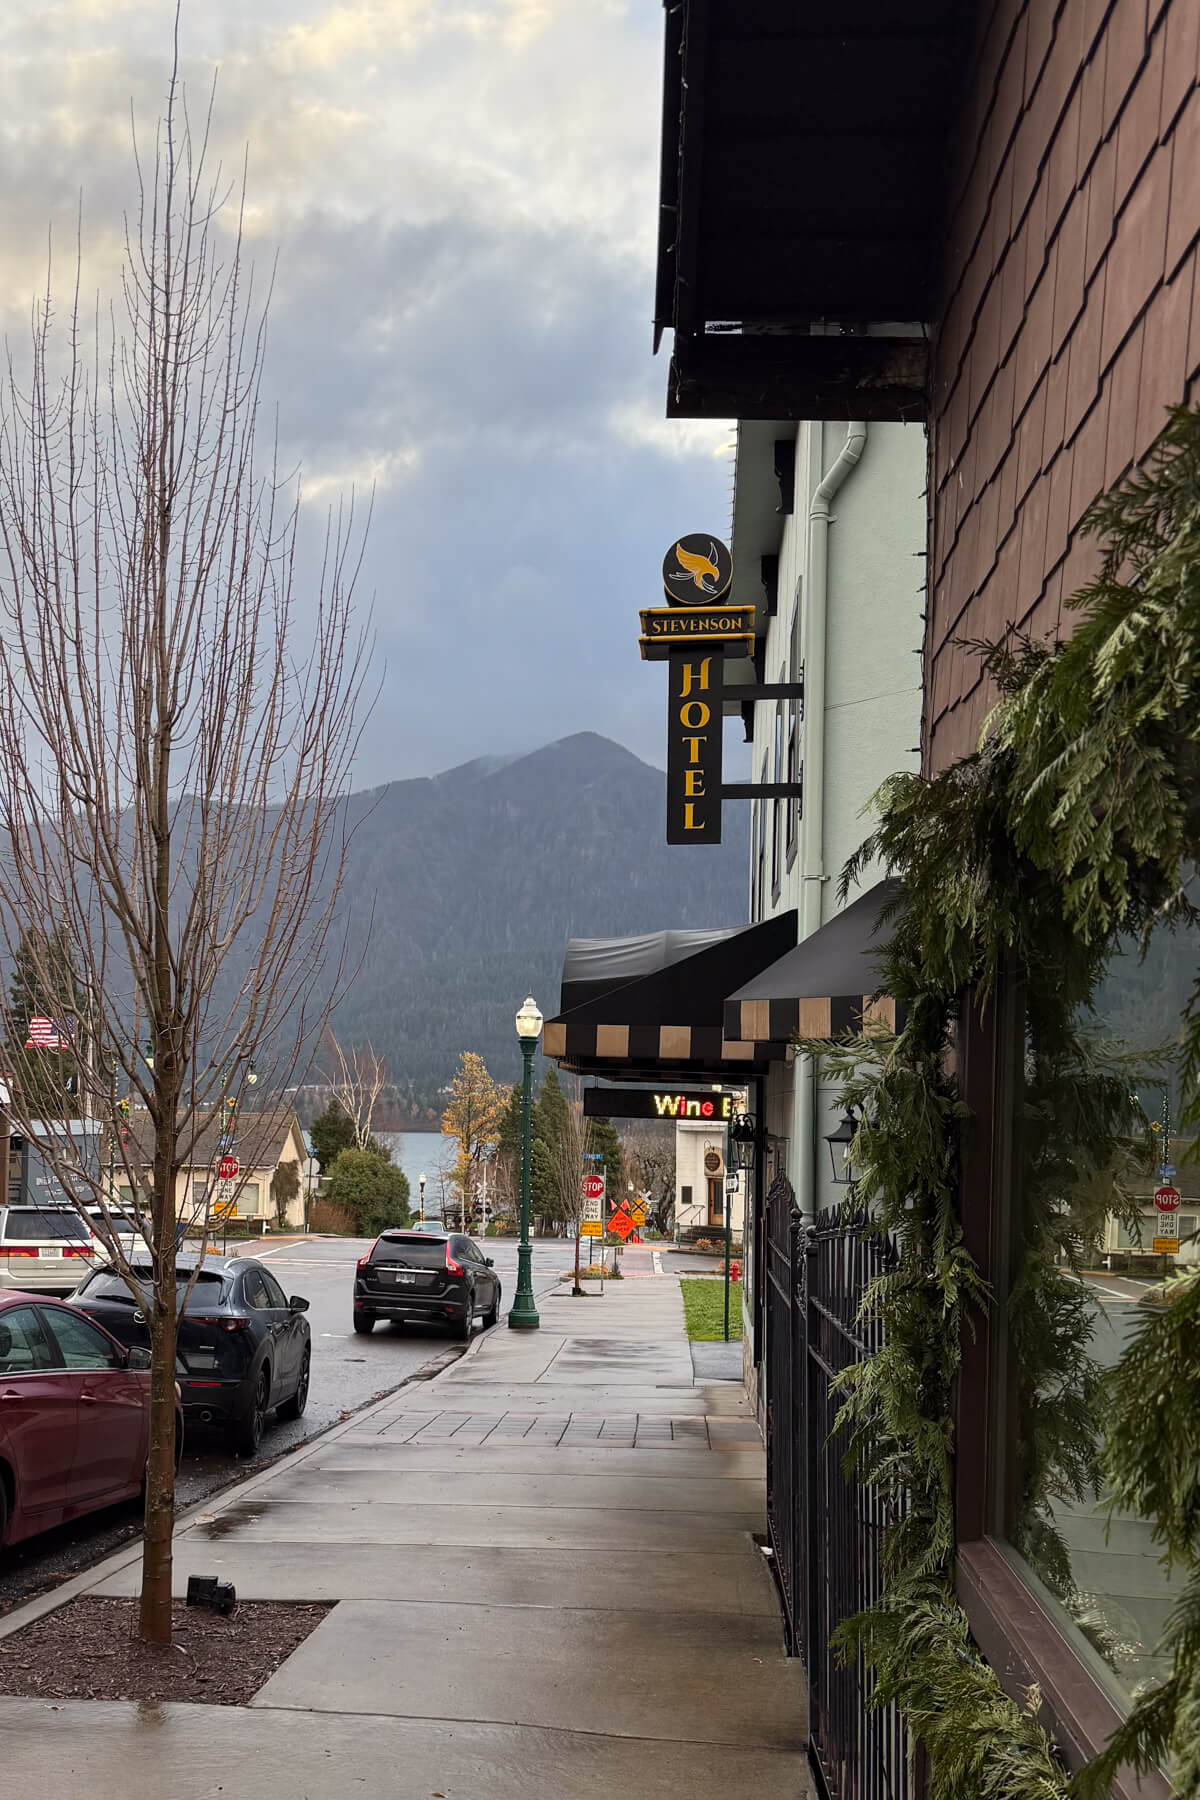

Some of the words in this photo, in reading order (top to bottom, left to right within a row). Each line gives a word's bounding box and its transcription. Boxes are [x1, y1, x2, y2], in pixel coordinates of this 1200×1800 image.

[652, 618, 742, 633] STEVENSON
[679, 657, 712, 830] HOTEL
[653, 1094, 714, 1117] Wine
[218, 1162, 238, 1173] TOP
[582, 1182, 603, 1192] STOP
